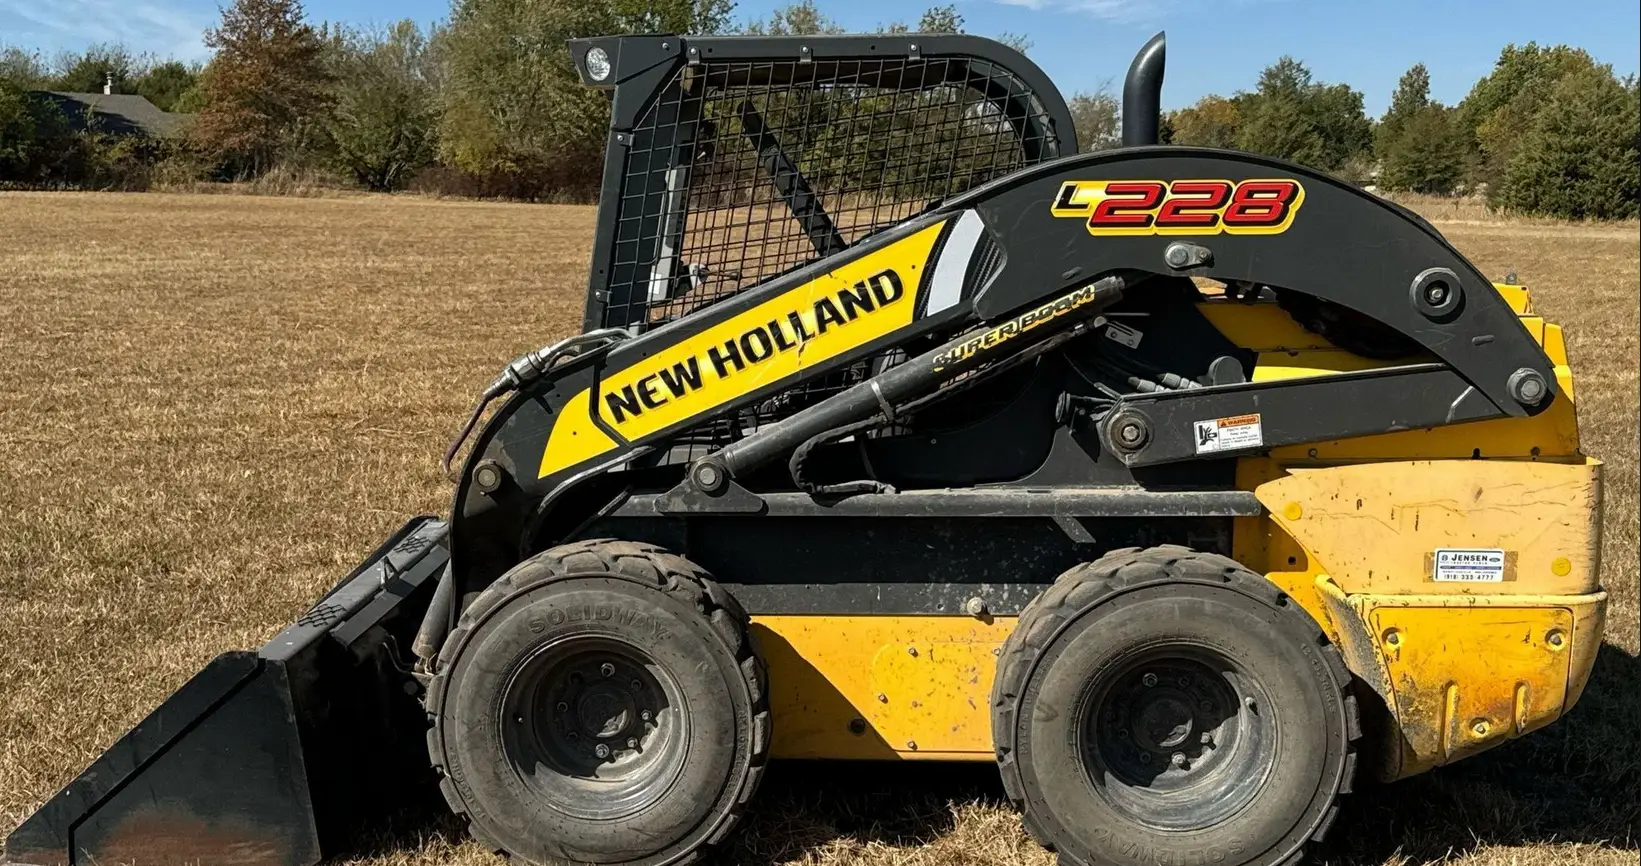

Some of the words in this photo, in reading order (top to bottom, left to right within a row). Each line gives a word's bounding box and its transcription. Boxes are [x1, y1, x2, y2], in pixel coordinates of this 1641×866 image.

[1053, 181, 1303, 233] L228
[604, 355, 702, 424] NEW
[707, 268, 904, 379] HOLLAND
[932, 320, 1018, 372] SUPER
[1019, 284, 1096, 332] BOOM
[1228, 417, 1256, 425] WARNING
[1451, 553, 1488, 561] JENSEN
[528, 603, 669, 638] SOLIDWAY
